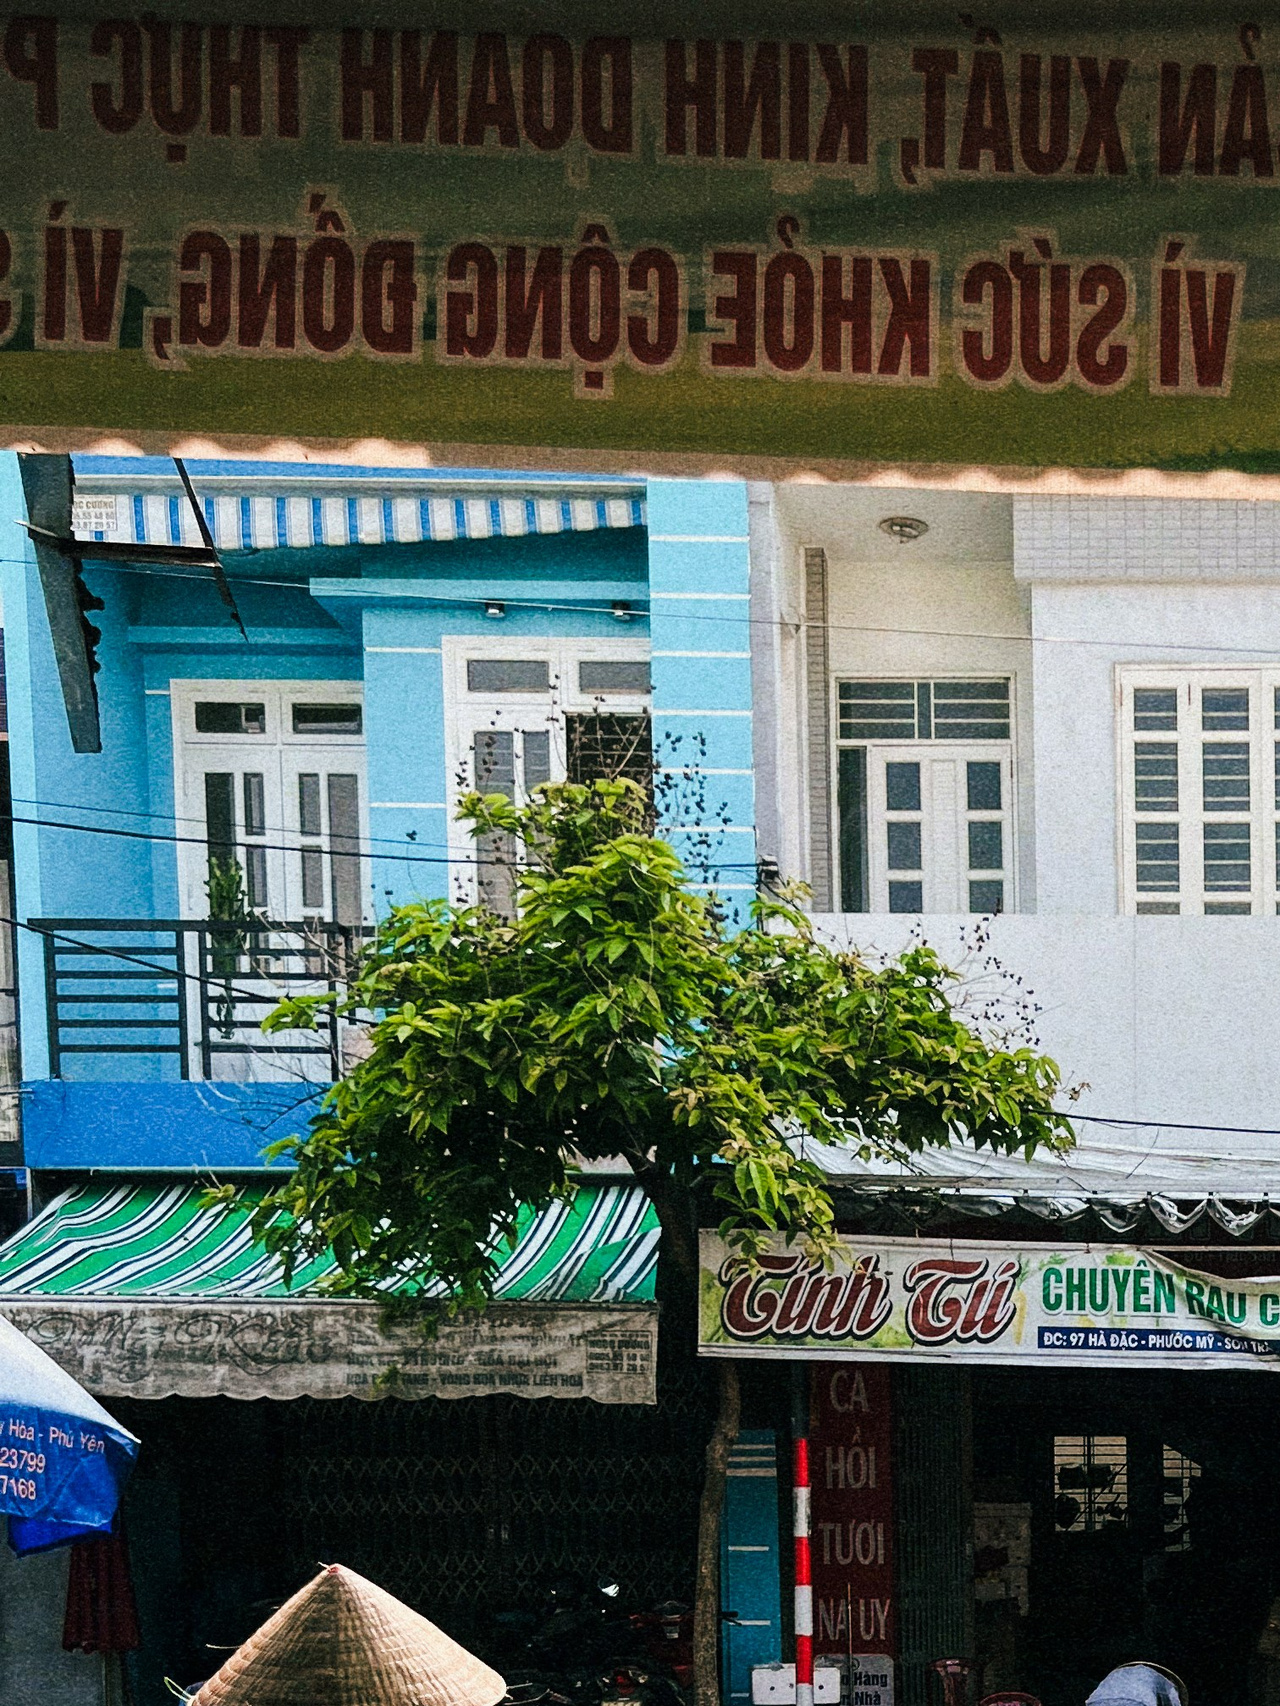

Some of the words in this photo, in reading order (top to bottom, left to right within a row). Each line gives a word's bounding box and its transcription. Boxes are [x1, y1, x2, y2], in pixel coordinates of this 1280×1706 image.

[1041, 1260, 1176, 1314] CHUYÊN
[1184, 1279, 1248, 1324] RAU
[1043, 1332, 1067, 1347] ĐC:
[1069, 1332, 1085, 1347] 97
[1088, 1328, 1106, 1348] HÀ
[1148, 1330, 1194, 1350] PHƯỚC
[1196, 1334, 1215, 1349] MỸ
[9, 1418, 35, 1441] Hòa
[49, 1426, 74, 1449] Phú
[80, 1430, 105, 1453] Yên
[818, 1520, 886, 1566] TƯƠI
[860, 1599, 891, 1641] UY
[853, 1671, 888, 1688] Hàng
[854, 1690, 882, 1706] Nhà
